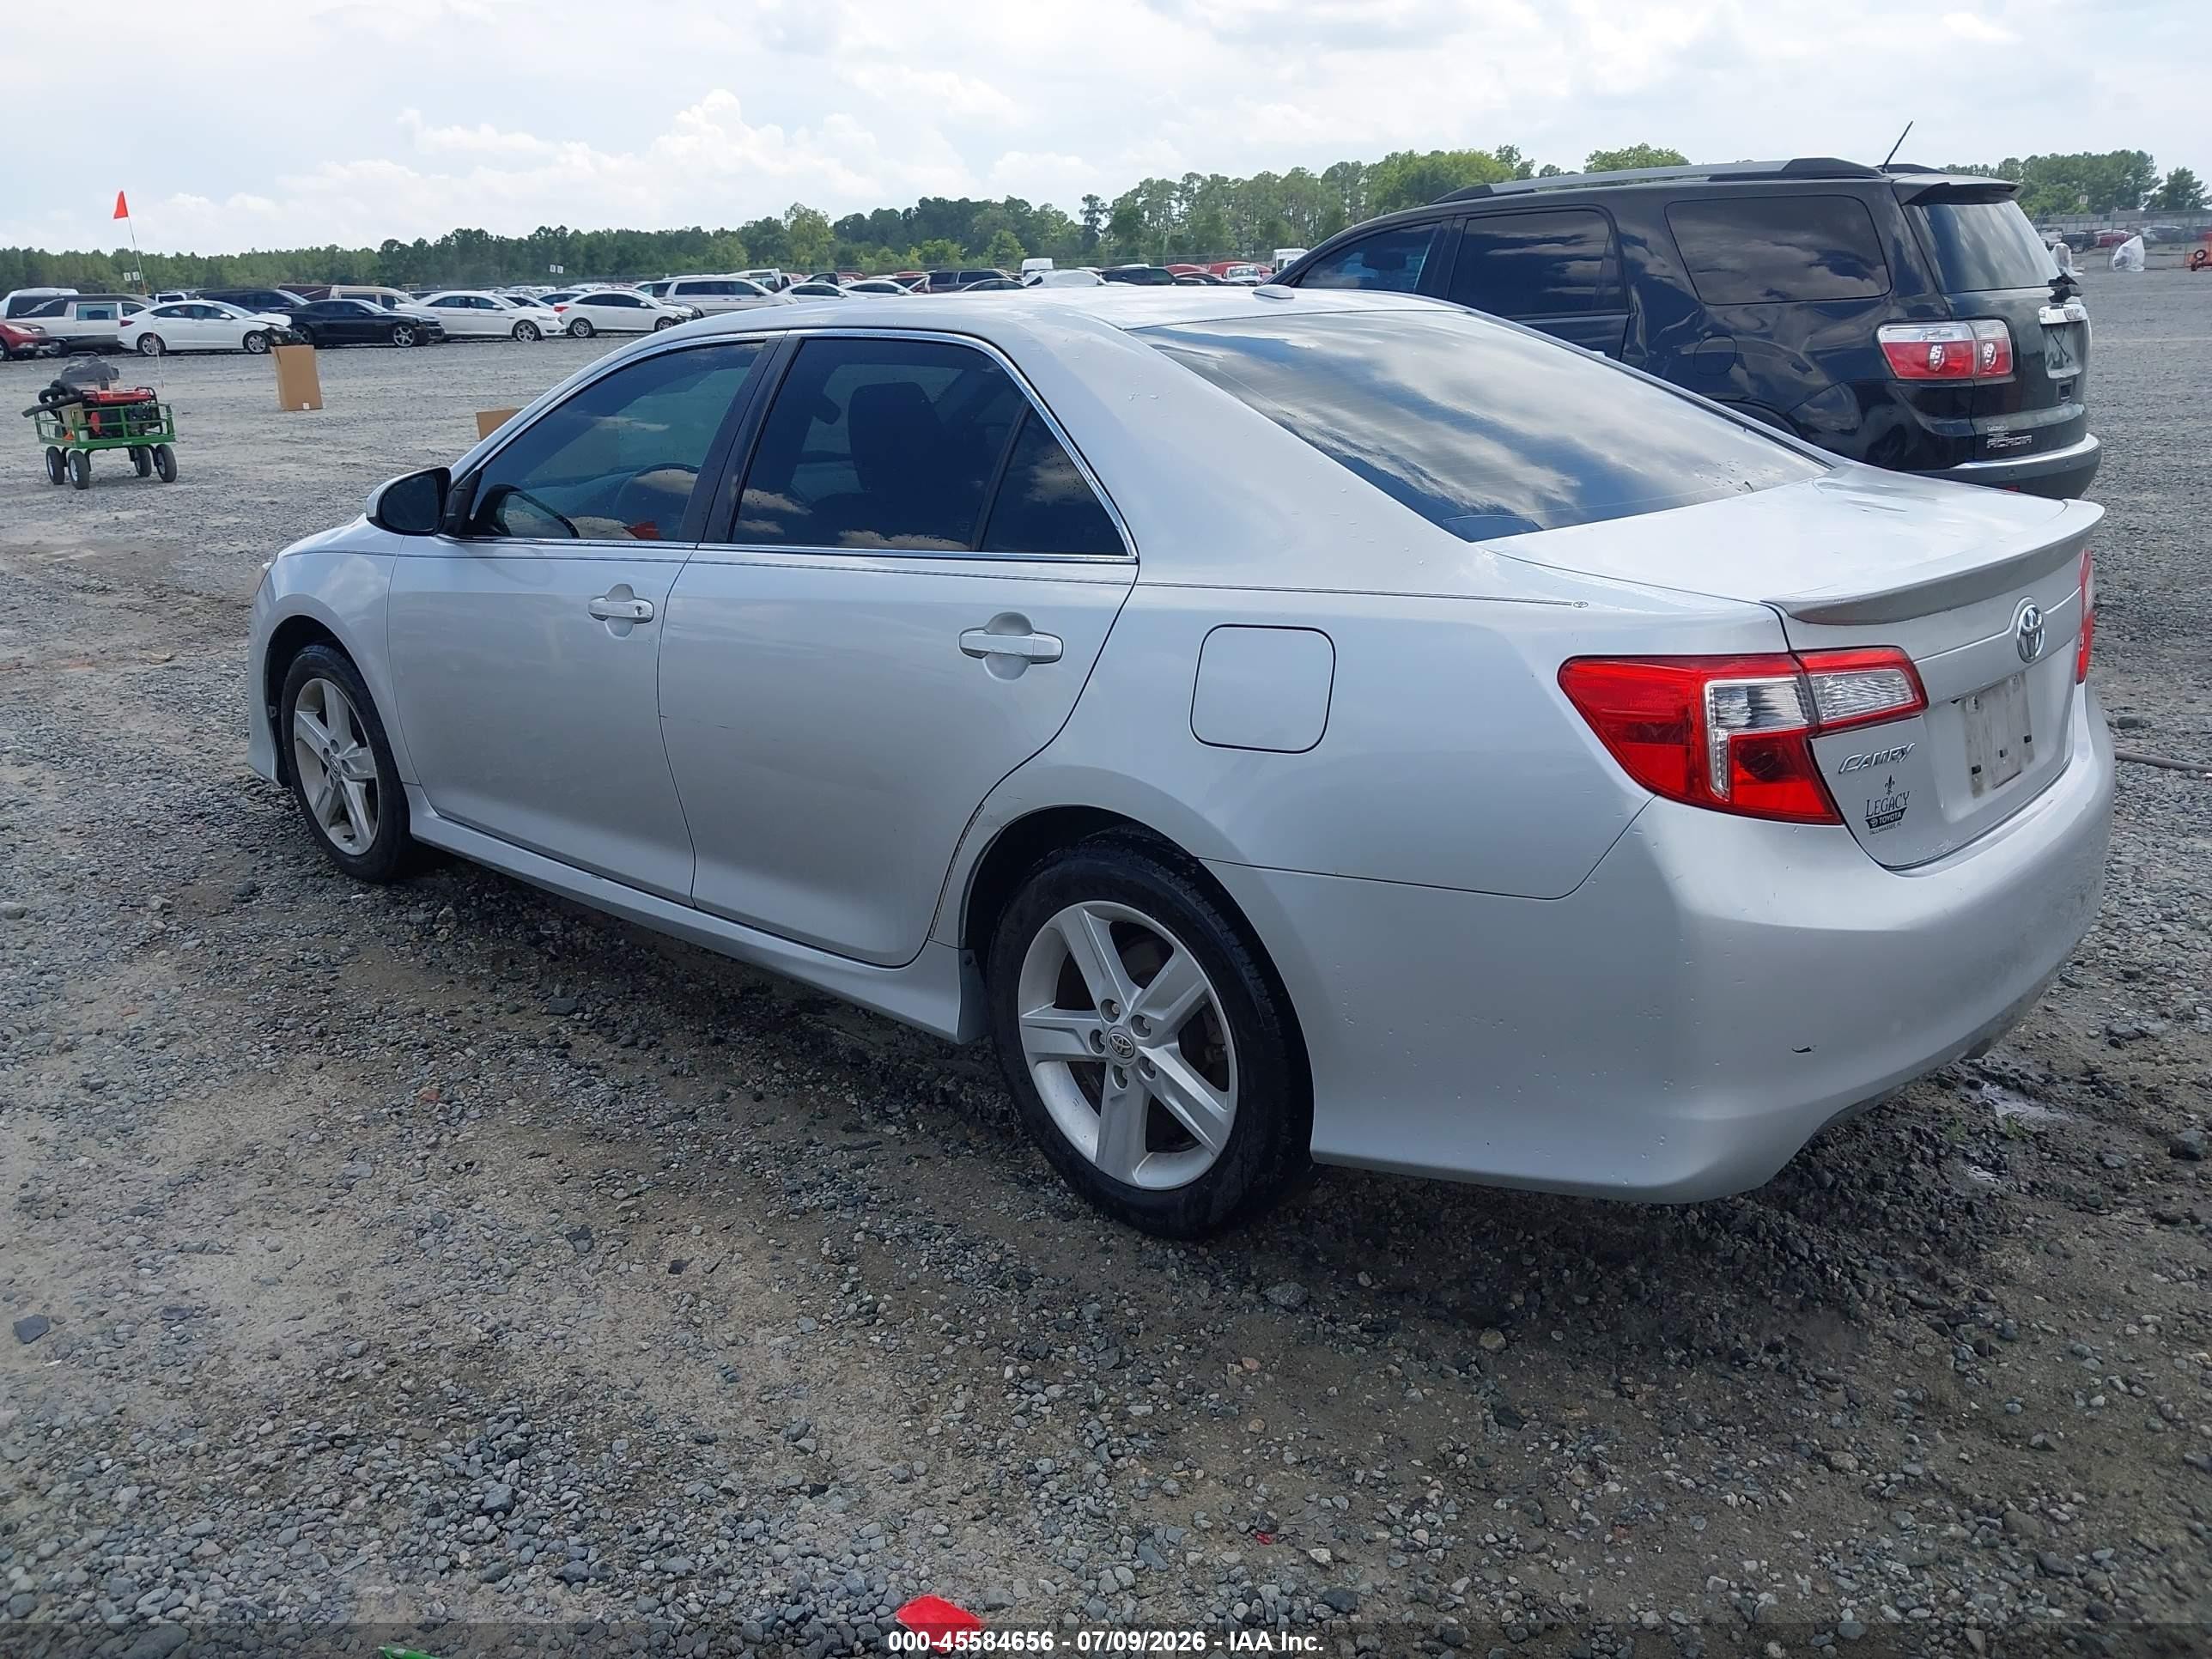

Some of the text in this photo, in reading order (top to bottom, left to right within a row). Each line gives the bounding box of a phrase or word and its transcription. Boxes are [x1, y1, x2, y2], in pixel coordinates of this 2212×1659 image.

[1838, 742, 1916, 775] CAMRY
[1865, 790, 1911, 818] LEGACY
[1879, 811, 1902, 824] TOYOTA
